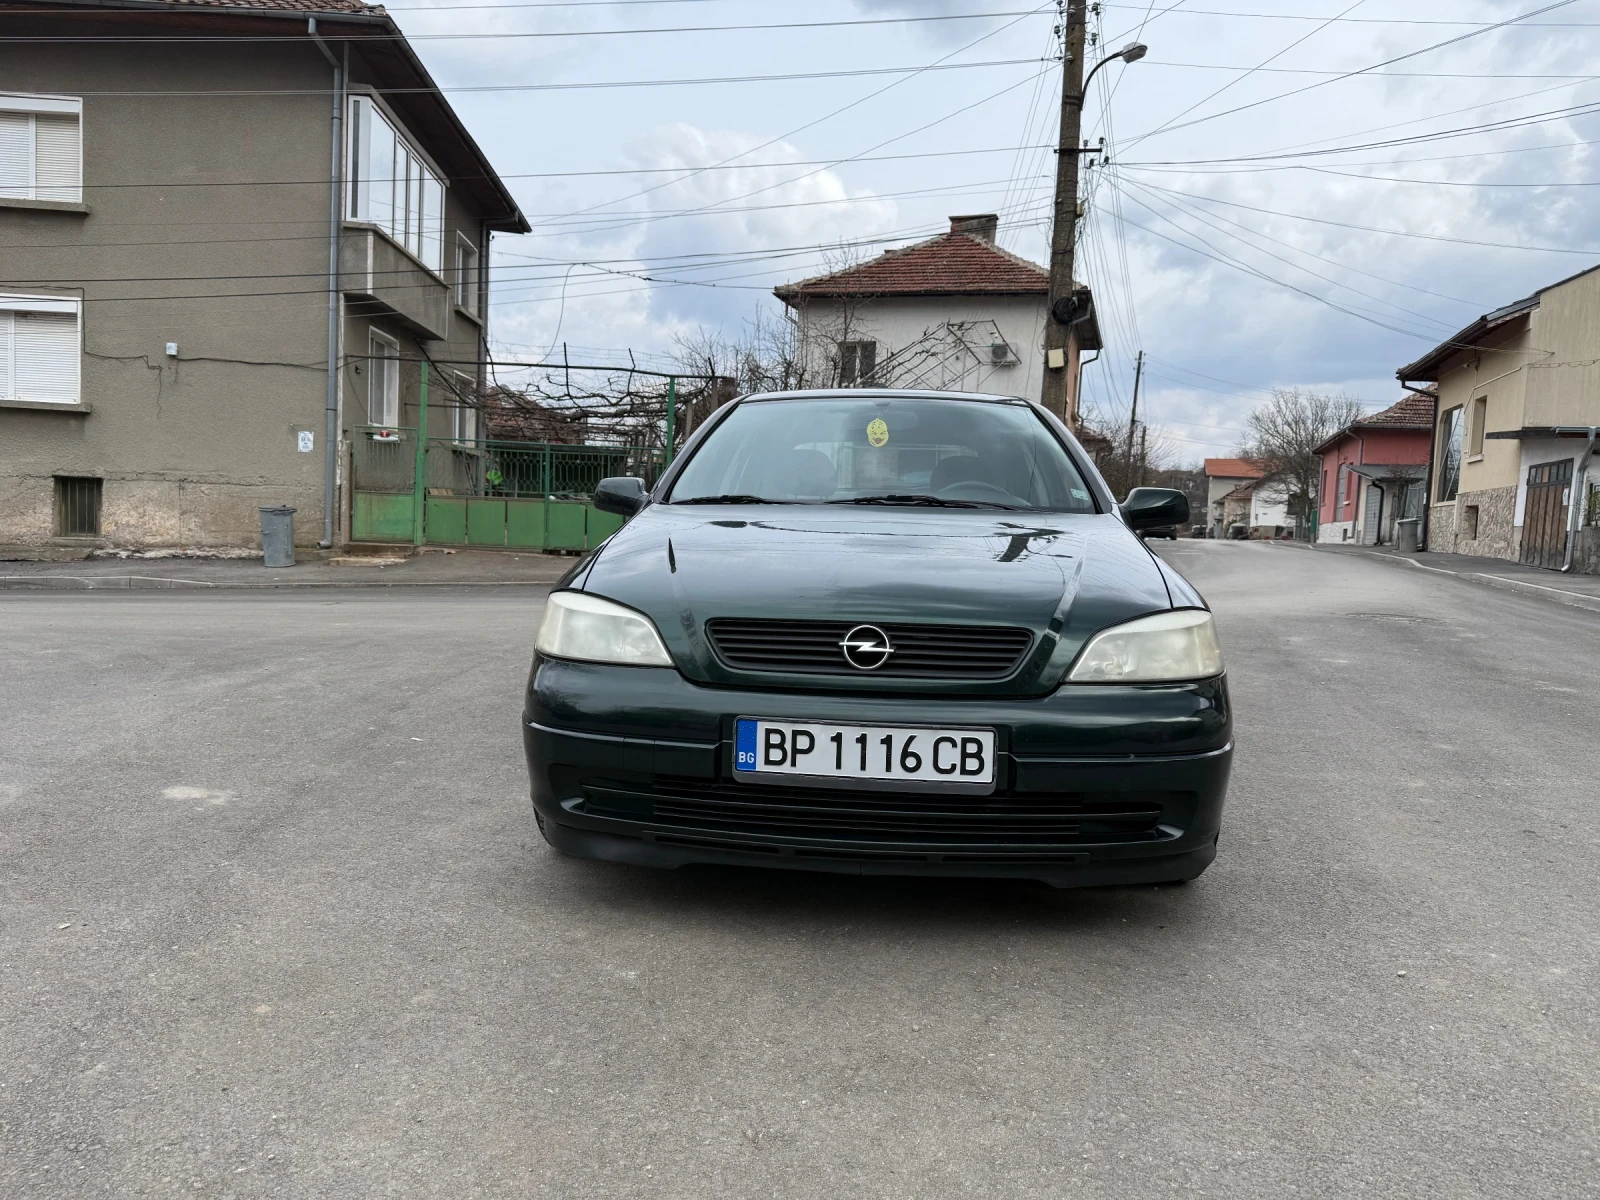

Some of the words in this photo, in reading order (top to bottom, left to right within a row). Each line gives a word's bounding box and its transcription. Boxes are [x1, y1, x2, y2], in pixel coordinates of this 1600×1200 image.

[738, 751, 755, 764] BG
[763, 727, 815, 767] BP
[830, 731, 922, 773] 1116
[932, 736, 985, 776] CB
